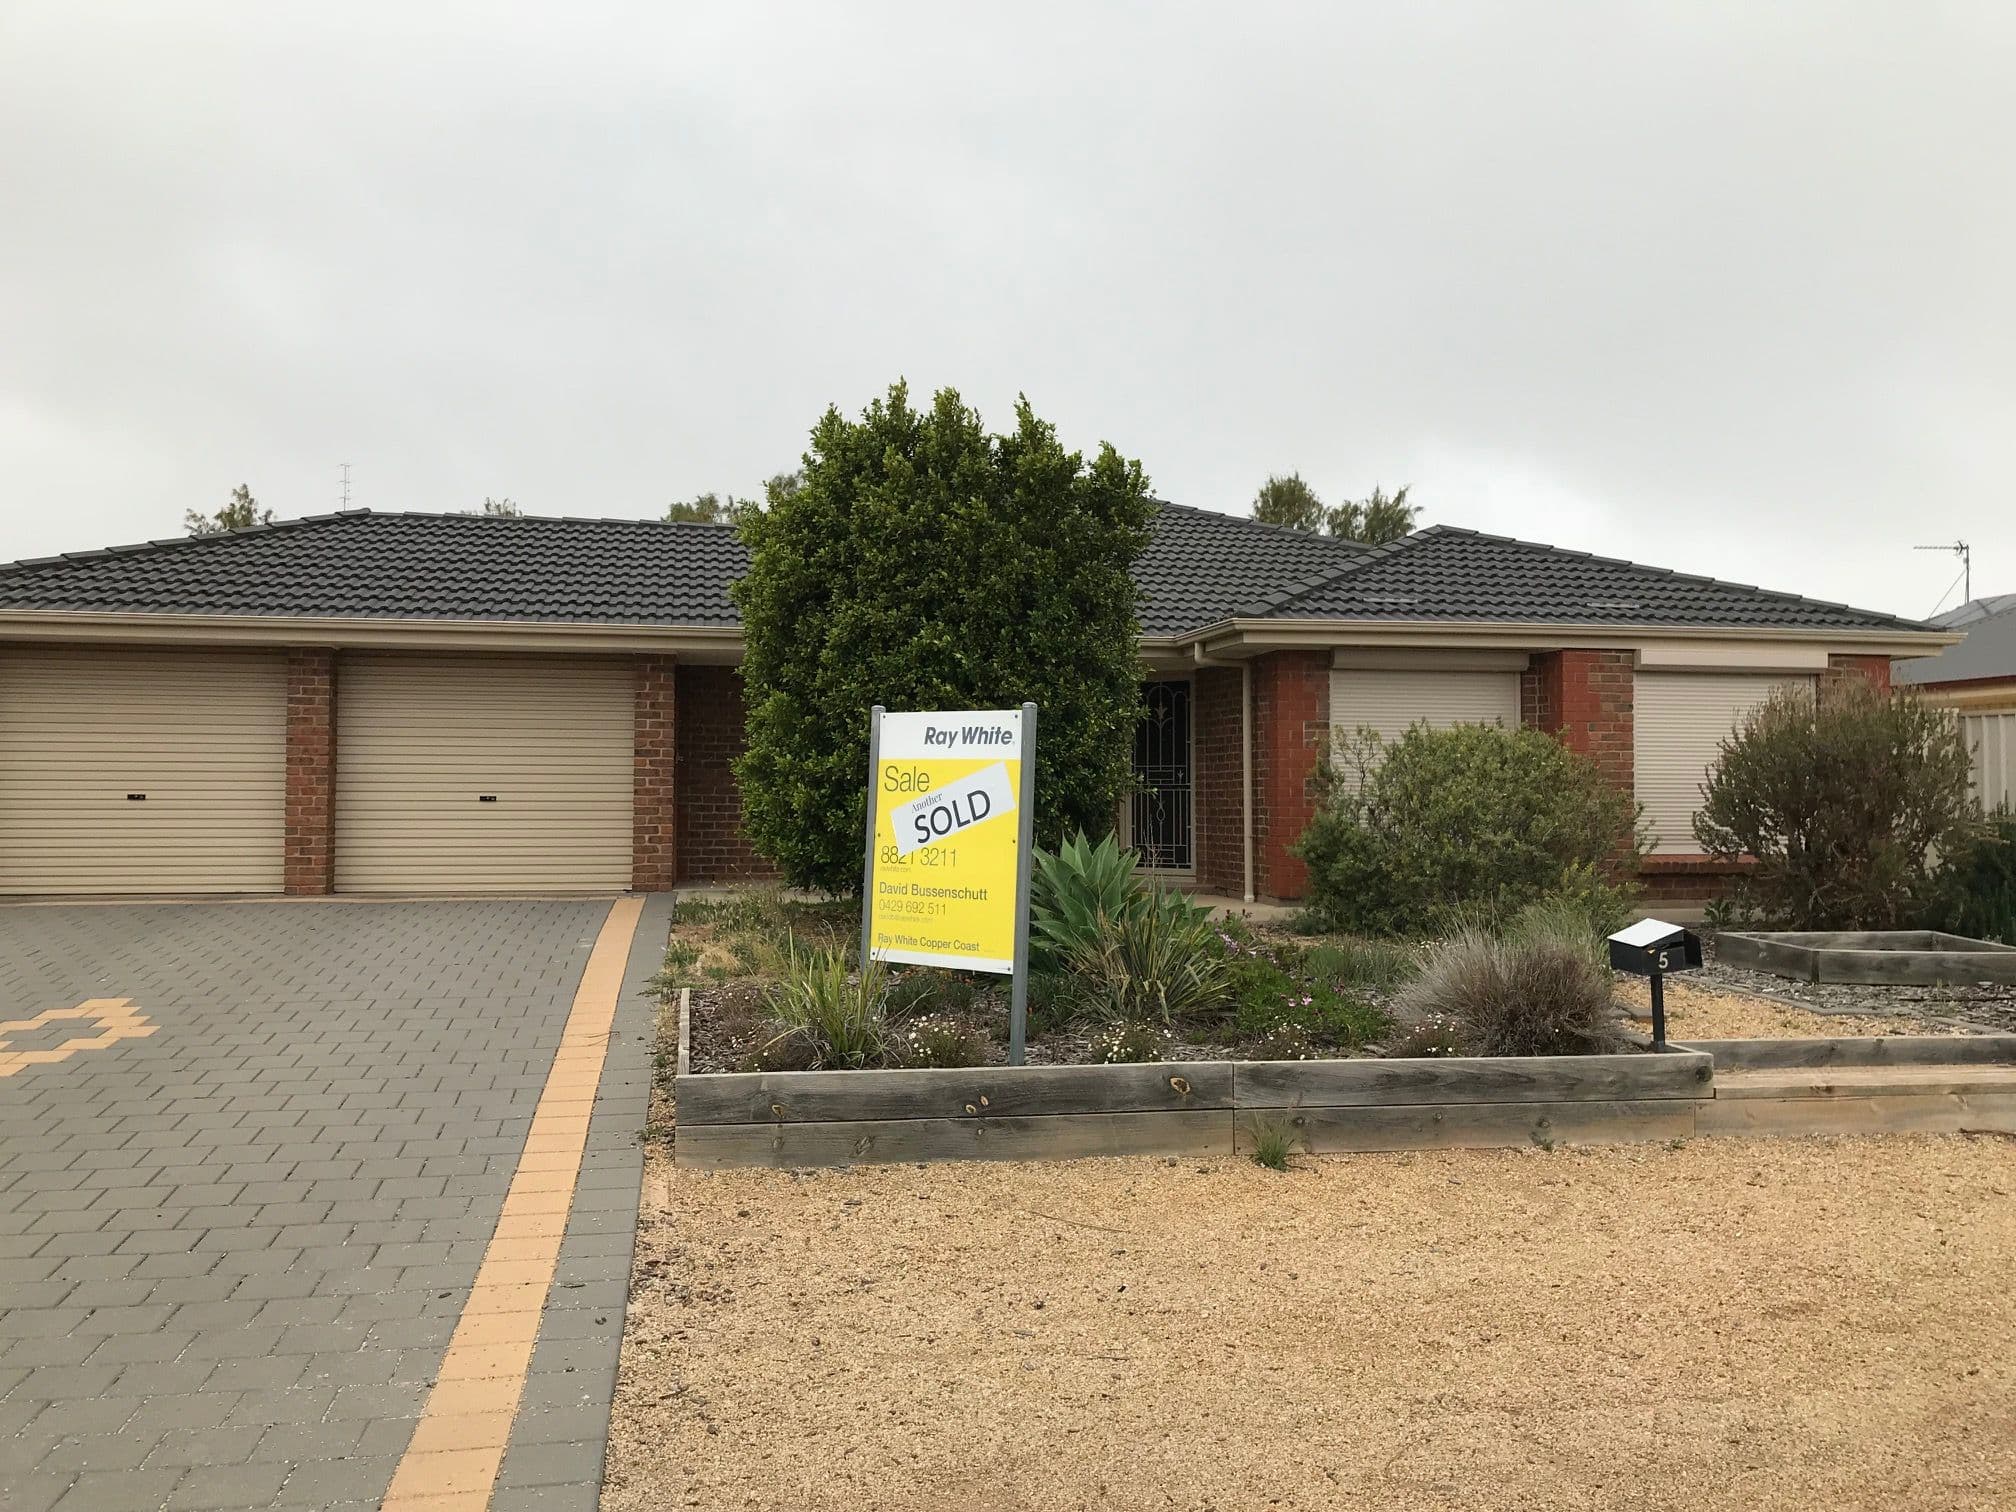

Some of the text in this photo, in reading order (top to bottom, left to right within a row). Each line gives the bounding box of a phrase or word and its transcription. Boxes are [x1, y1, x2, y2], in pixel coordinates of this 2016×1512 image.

[924, 726, 1013, 748] Ray White
[884, 765, 930, 792] Sale
[911, 793, 944, 813] Another
[914, 790, 991, 844] SOLD
[920, 847, 956, 867] 3211
[879, 881, 988, 901] David Bussenschutt
[879, 899, 946, 915] 0429 692 511
[878, 933, 980, 952] Ray White Copper Coast
[1658, 951, 1669, 969] 5
